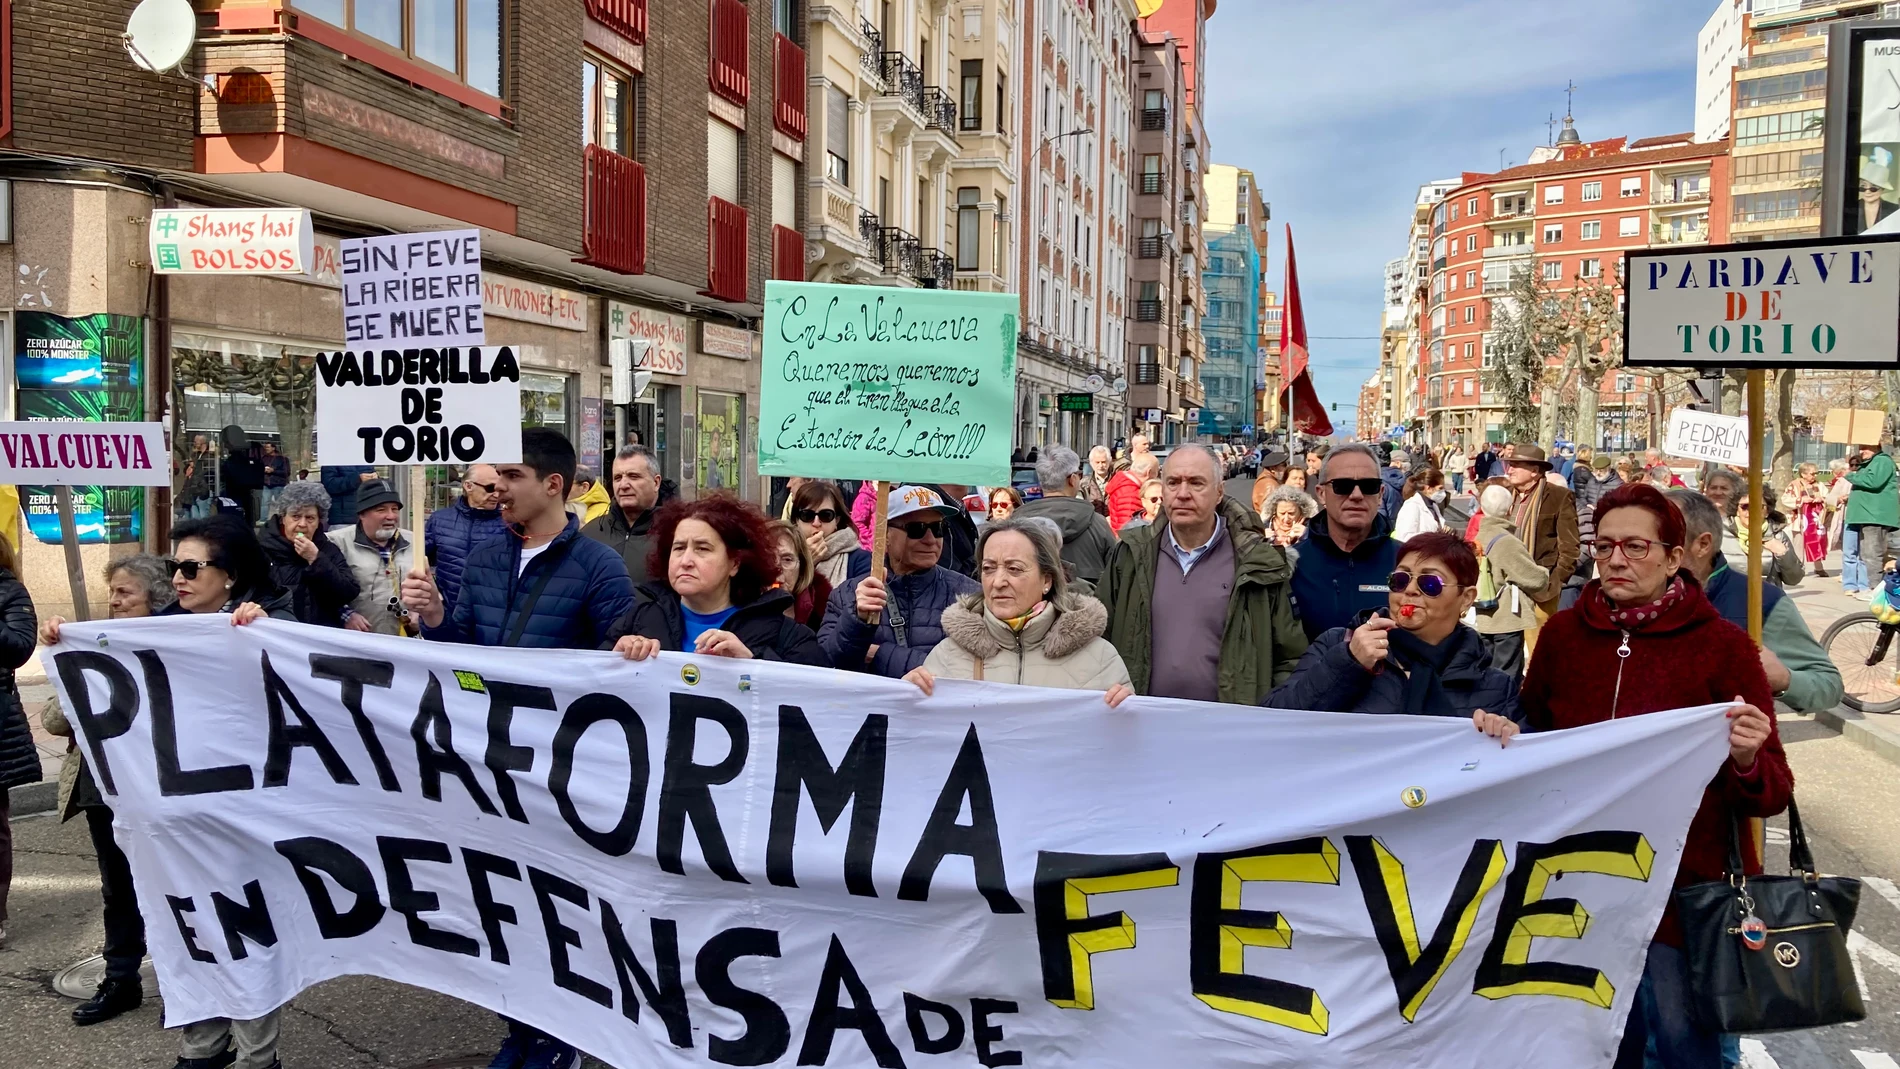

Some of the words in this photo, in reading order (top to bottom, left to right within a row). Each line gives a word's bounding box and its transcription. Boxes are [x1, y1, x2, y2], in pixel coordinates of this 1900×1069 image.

[188, 214, 255, 243] Shang
[261, 214, 295, 237] hai
[190, 249, 294, 270] BOLSOS
[408, 237, 479, 269] FEVE
[1648, 251, 1873, 290] PARDAVE
[344, 282, 377, 307] LA
[1725, 290, 1782, 321] DE
[346, 313, 383, 341] SE
[390, 304, 483, 339] MUERE
[629, 310, 665, 346] Shang
[667, 316, 685, 343] hai
[817, 296, 857, 343] La
[860, 296, 979, 343] Valcueva
[27, 339, 48, 348] ZERO
[49, 338, 82, 349] AZÚCAR
[27, 349, 49, 358] 100%
[50, 349, 90, 359] MONSTER
[1677, 324, 1836, 354] TORIO
[316, 346, 520, 387] VALDERILLA
[783, 350, 890, 384] Queremos
[893, 363, 980, 391] queremos
[401, 388, 443, 424] DE
[803, 389, 831, 416] que
[834, 384, 851, 406] el
[856, 388, 889, 412] tren
[357, 424, 485, 463] TORIO
[776, 413, 863, 450] Estación
[865, 426, 886, 452] de
[1678, 443, 1688, 451] DE
[0, 433, 153, 469] VALCUEVA
[29, 495, 50, 504] ZERO
[29, 505, 51, 514] 100%
[55, 649, 1025, 914] PLATAFORMA
[1035, 831, 1657, 1036] FEVE
[165, 879, 278, 964] EN
[274, 835, 908, 1069] DEFENSA
[903, 991, 1023, 1069] DE
